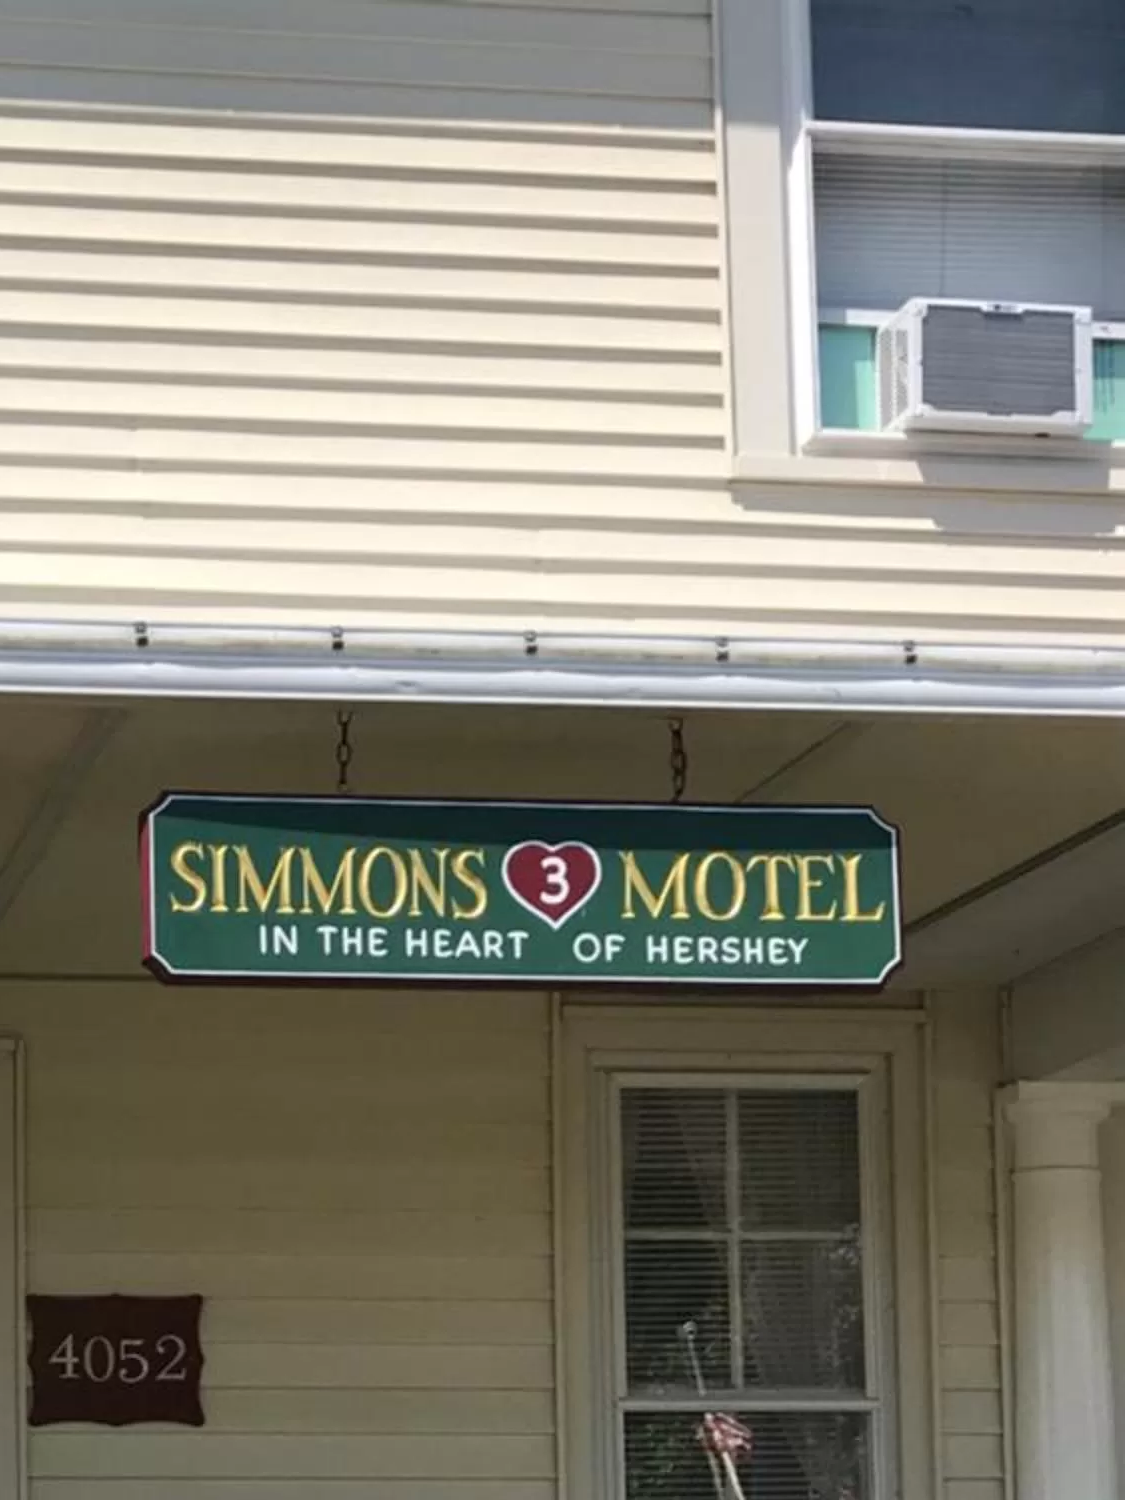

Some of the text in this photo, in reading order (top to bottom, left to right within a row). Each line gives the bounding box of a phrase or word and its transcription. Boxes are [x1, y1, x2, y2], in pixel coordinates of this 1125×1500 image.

[170, 841, 885, 922] SIMMONS 3 MOTEL
[259, 925, 809, 965] IN THE HEART OF HERSHEY
[48, 1333, 187, 1383] 4052
